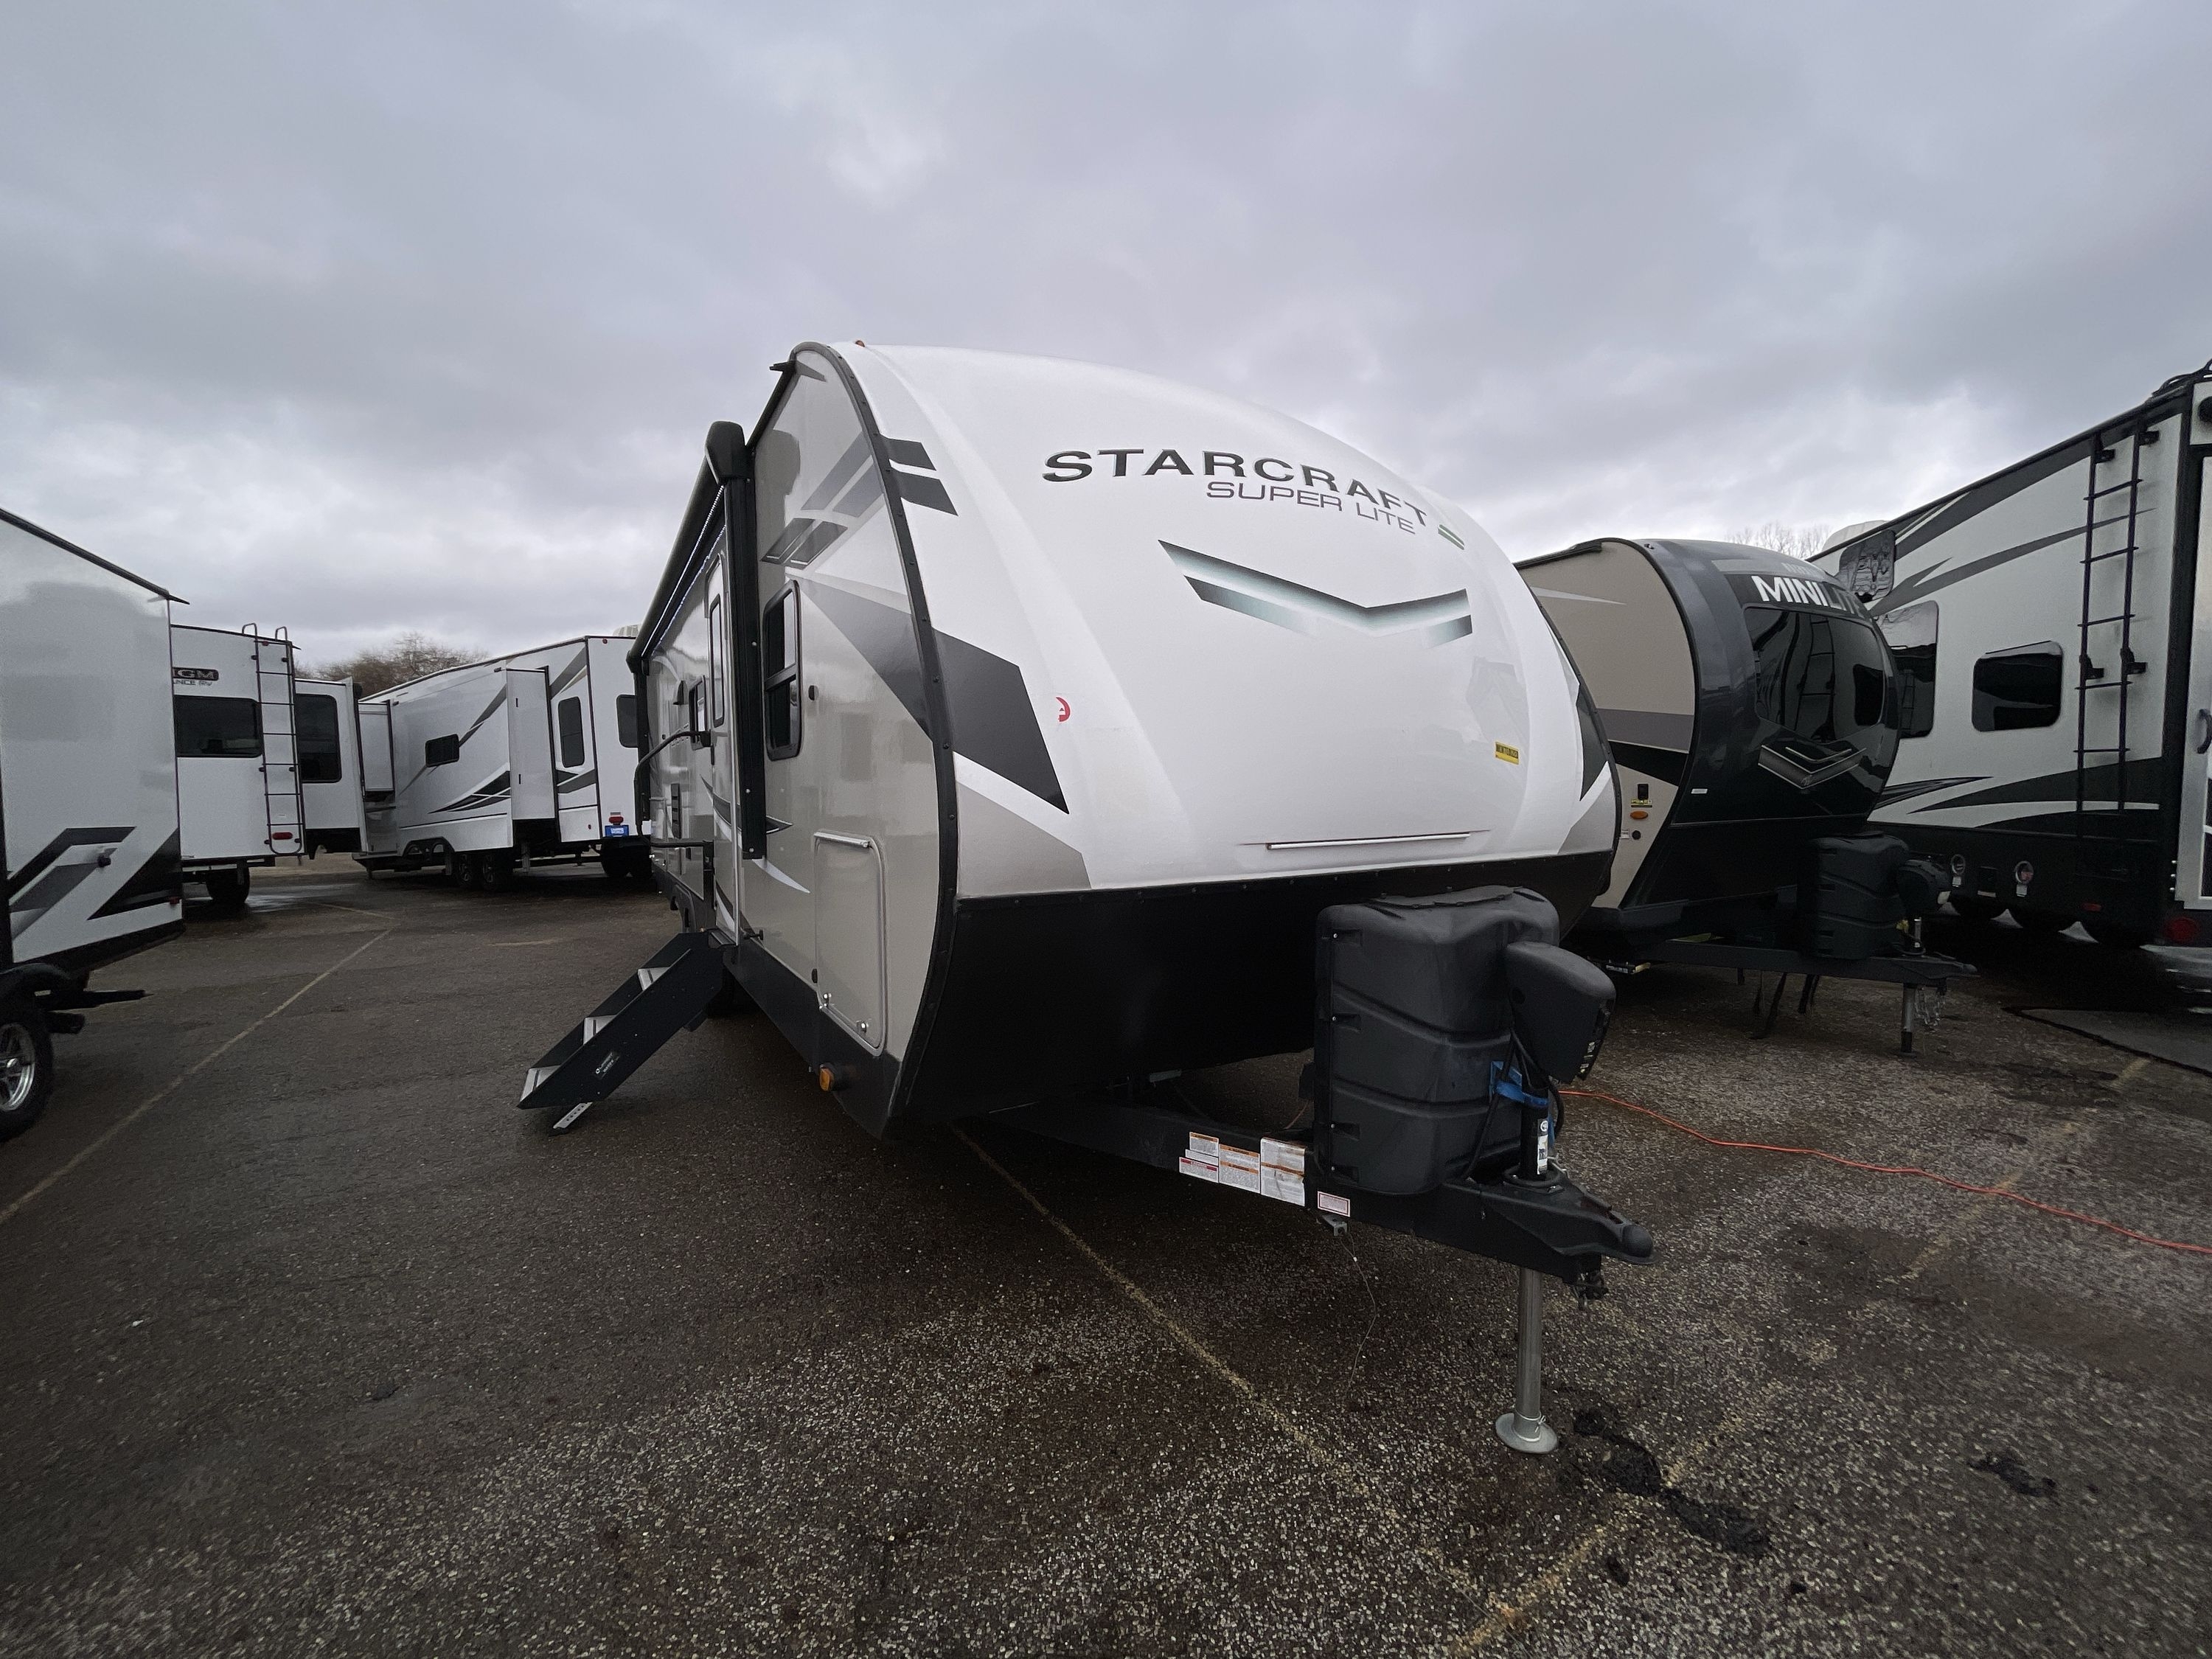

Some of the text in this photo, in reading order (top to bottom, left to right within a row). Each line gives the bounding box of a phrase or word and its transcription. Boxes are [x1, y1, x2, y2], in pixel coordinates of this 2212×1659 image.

[1042, 448, 1427, 526] STARCRAFT
[1206, 481, 1416, 535] SUPER LITE
[1750, 575, 1829, 607] MINI
